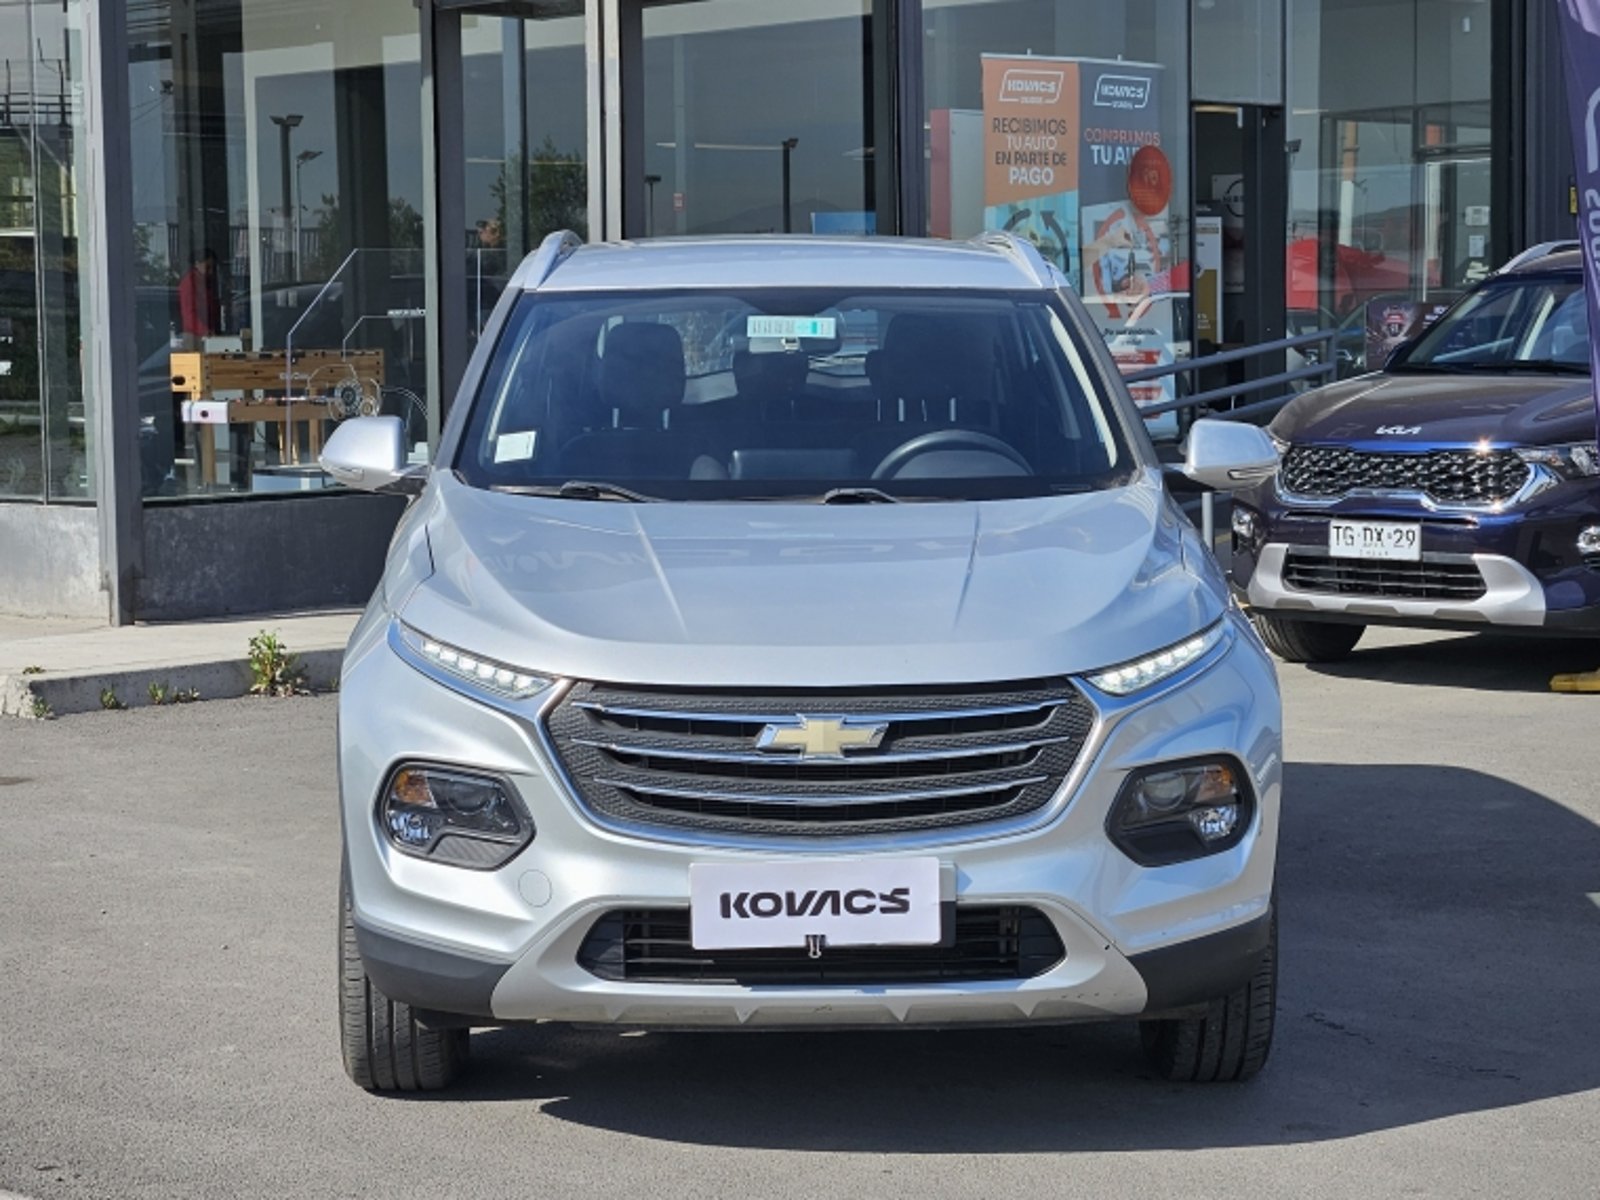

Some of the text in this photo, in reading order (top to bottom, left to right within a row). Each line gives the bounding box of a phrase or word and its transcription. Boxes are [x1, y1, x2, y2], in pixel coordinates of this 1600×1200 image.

[992, 117, 1068, 136] RECIBIMOS
[1006, 135, 1057, 151] TU AUTO
[995, 151, 1068, 167] EN PARTE DE
[1090, 145, 1112, 165] TU
[1009, 167, 1054, 186] PAGO
[720, 888, 910, 919] KOVACS
